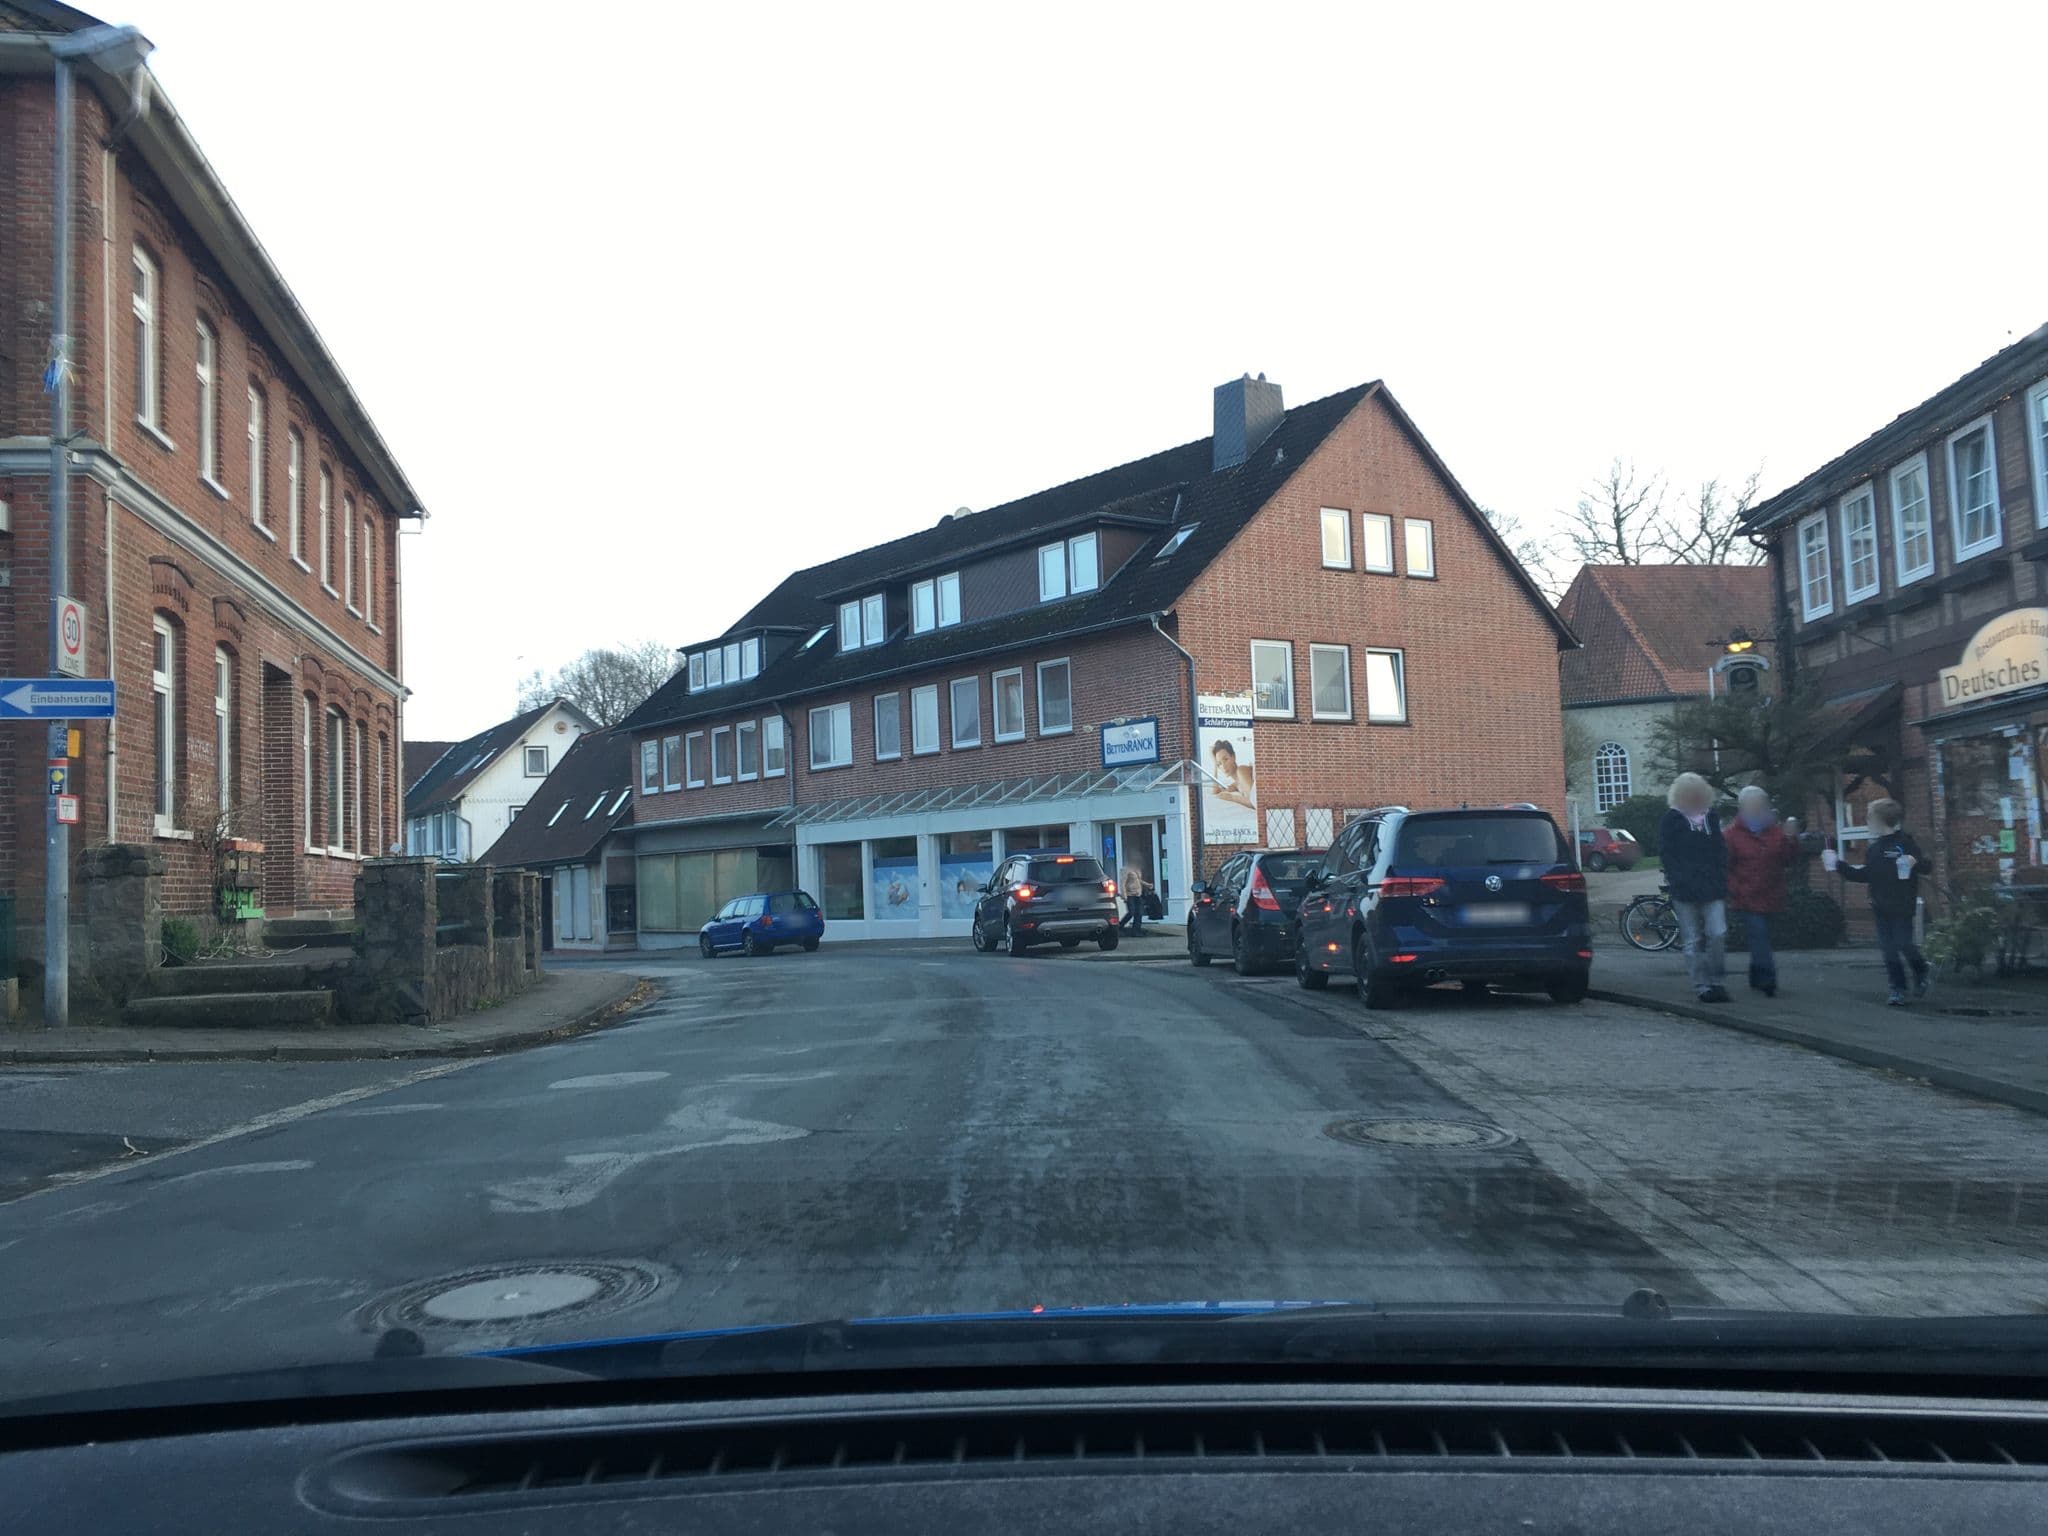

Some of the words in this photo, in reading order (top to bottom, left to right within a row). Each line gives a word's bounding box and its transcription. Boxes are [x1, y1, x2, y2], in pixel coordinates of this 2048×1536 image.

[66, 617, 77, 642] 30
[64, 656, 80, 672] ZONE
[1944, 657, 2040, 700] Deutsches
[30, 694, 109, 704] Einbahnstraße
[1204, 718, 1249, 728] Schlafsysteme
